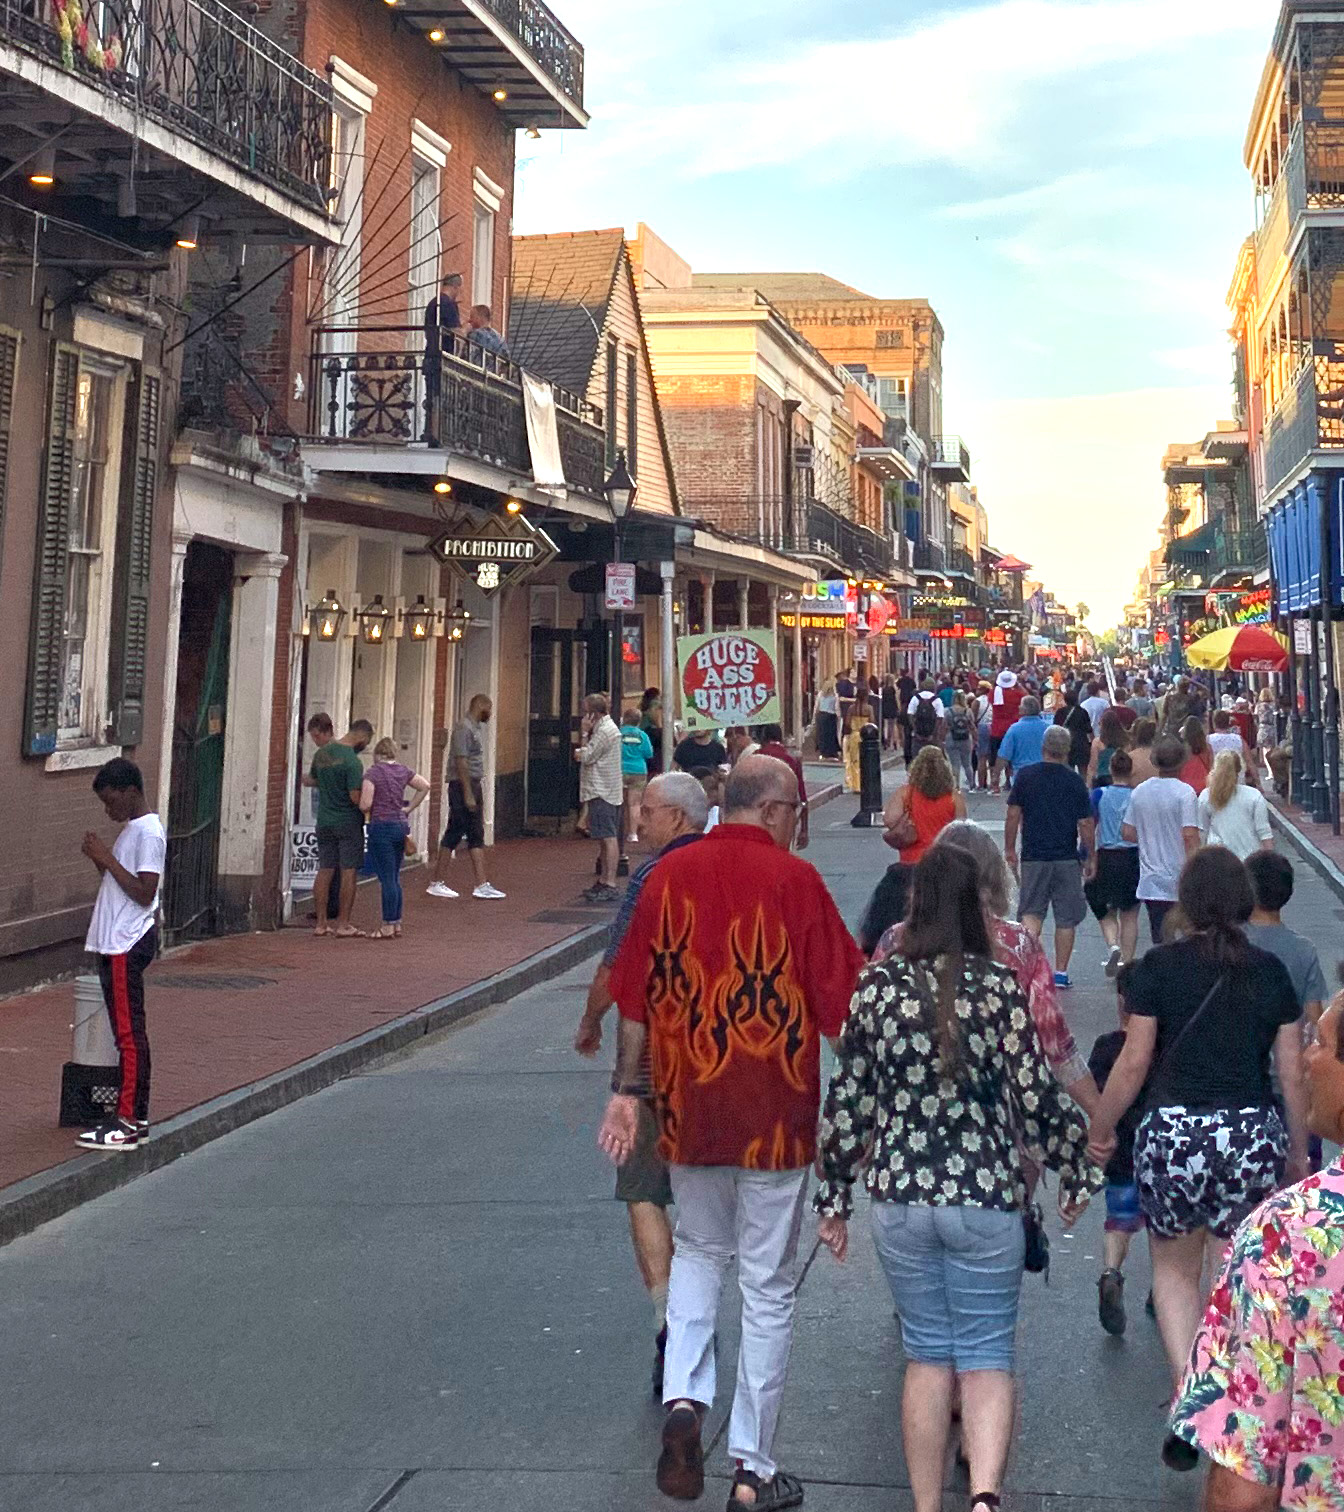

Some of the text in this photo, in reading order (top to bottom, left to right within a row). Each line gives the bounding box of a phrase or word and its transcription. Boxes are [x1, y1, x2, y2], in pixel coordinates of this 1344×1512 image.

[444, 539, 534, 558] PROHIBITION
[825, 616, 844, 628] SLICE
[696, 638, 759, 670] HUGE
[702, 663, 755, 687] ASS
[694, 683, 767, 713] BEERS
